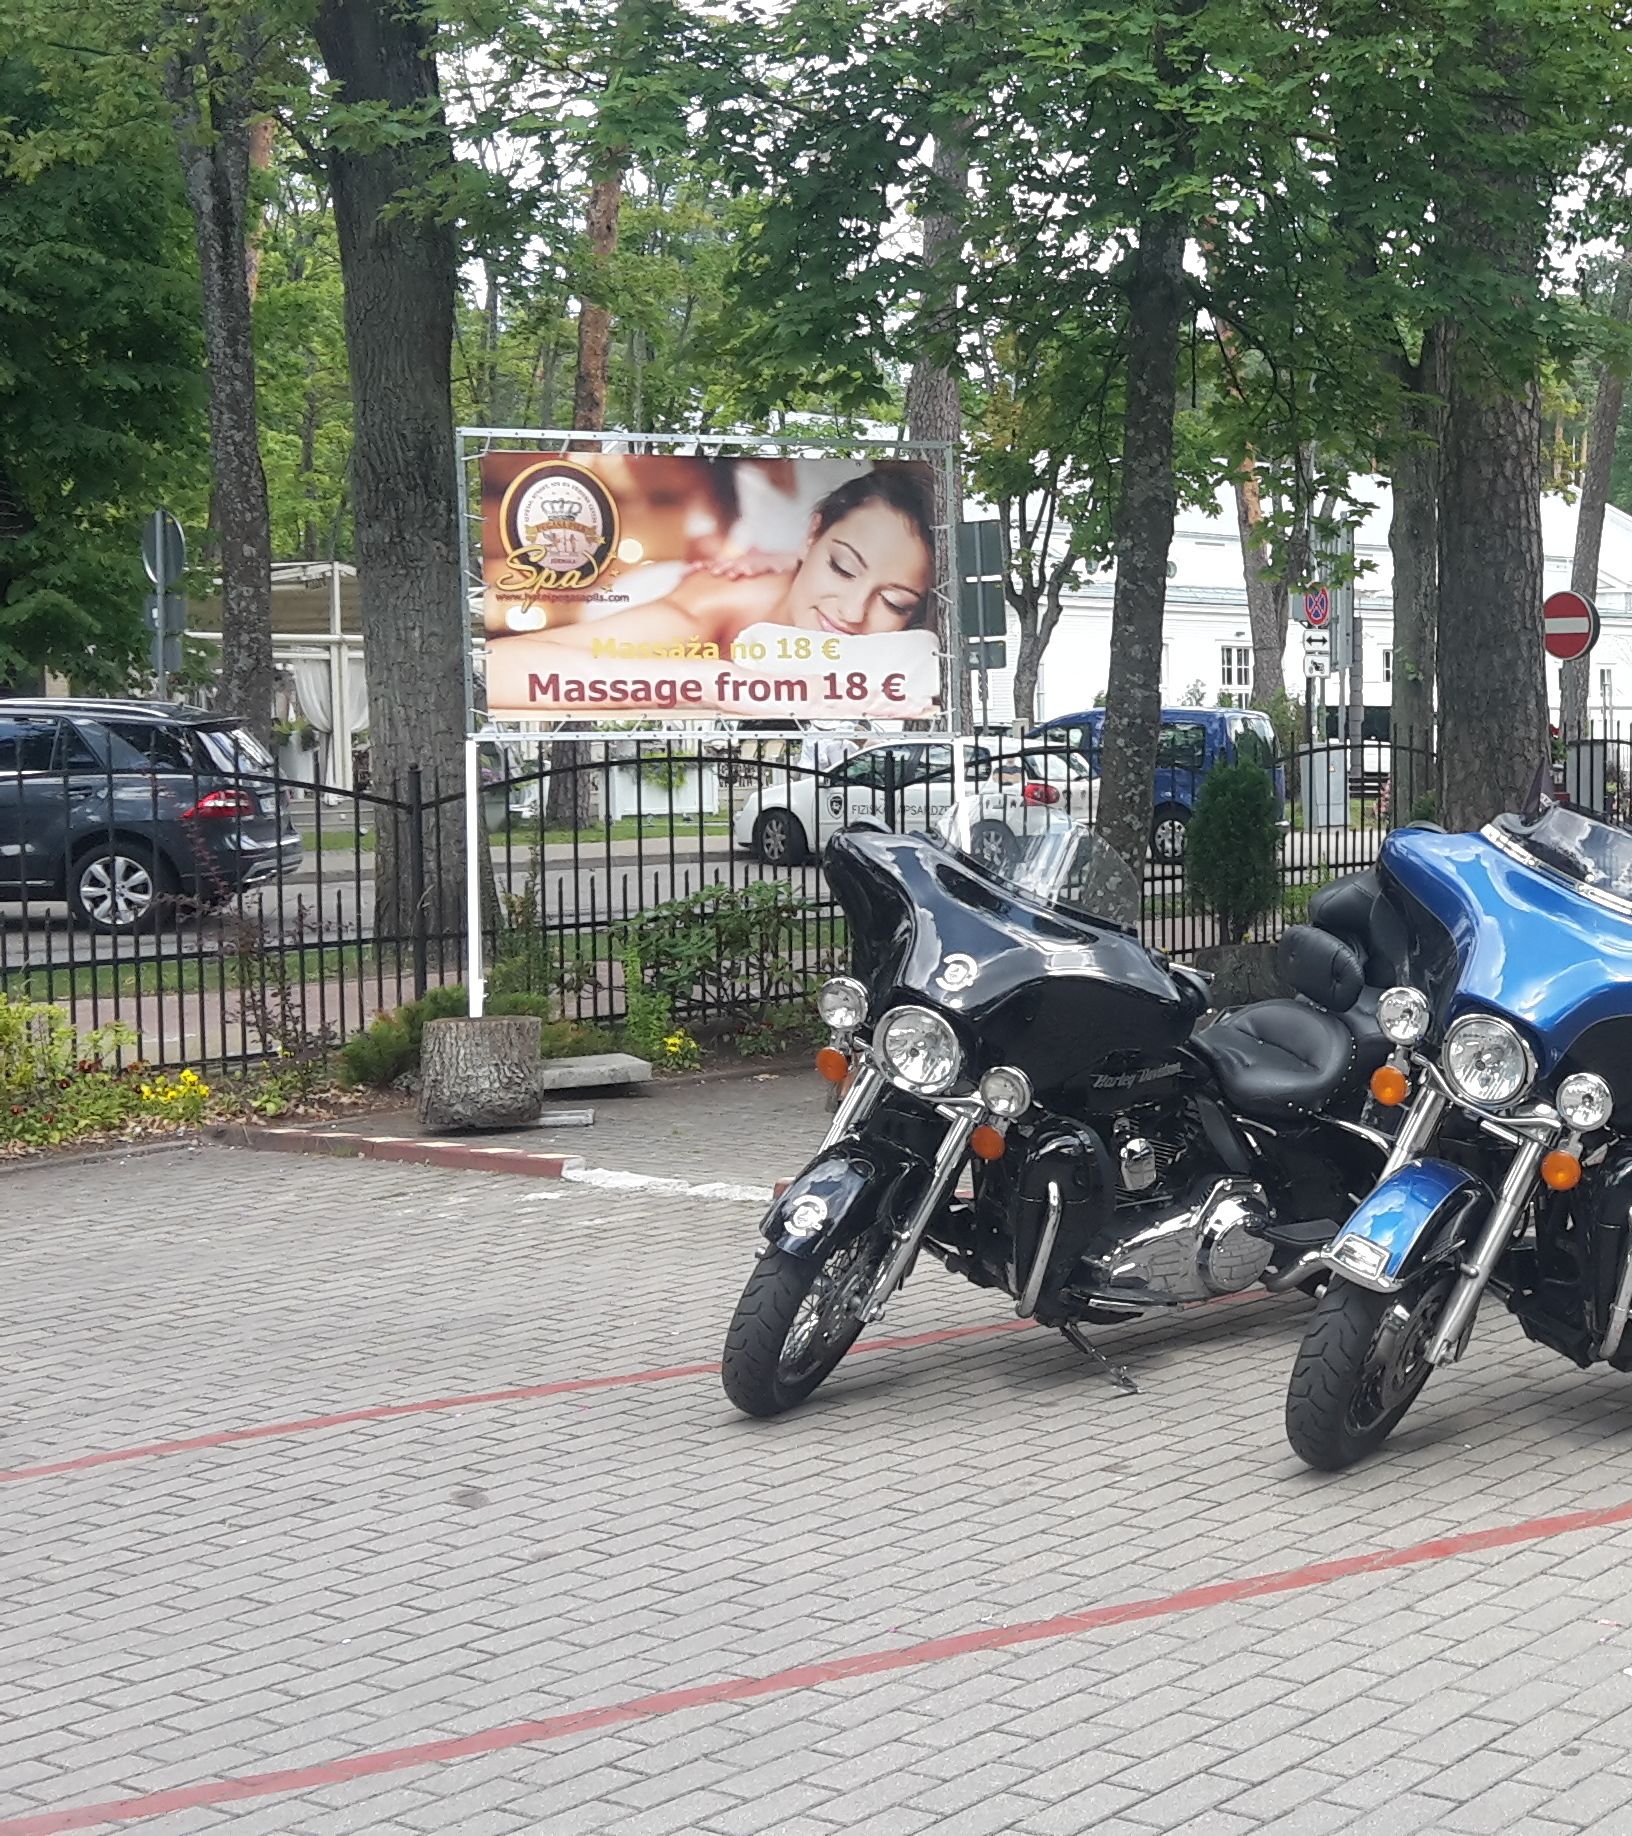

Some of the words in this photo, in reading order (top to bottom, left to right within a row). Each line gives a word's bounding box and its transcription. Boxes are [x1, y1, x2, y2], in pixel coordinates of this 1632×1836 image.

[496, 544, 599, 612] Spa
[731, 641, 766, 660] no
[776, 637, 811, 660] 18
[821, 638, 841, 660] €
[528, 672, 703, 709] Massage
[715, 672, 808, 702] from
[823, 672, 868, 701] 18
[881, 673, 906, 702] €
